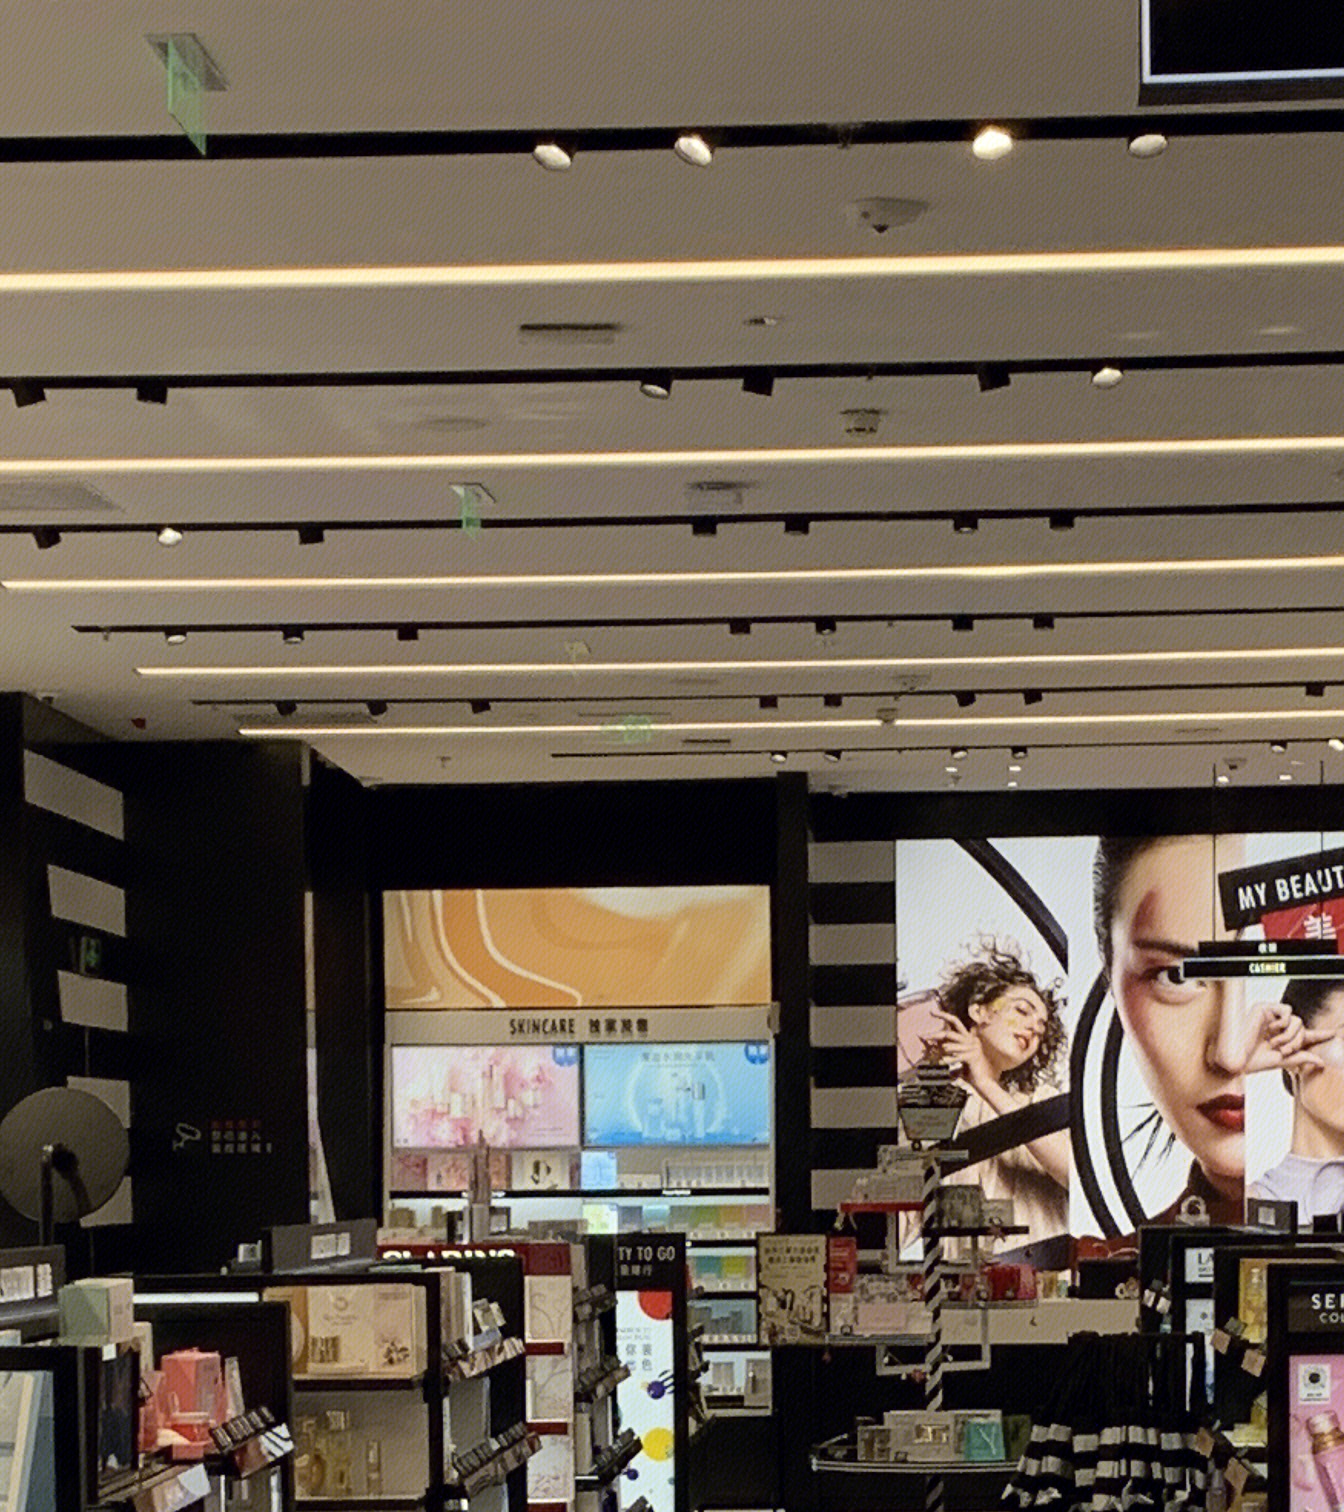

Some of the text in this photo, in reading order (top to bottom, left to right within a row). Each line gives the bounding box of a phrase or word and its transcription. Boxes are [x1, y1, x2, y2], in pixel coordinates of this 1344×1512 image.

[1237, 882, 1268, 911] MY
[1249, 963, 1287, 974] CASHIER
[509, 1018, 576, 1035] SKINCARE
[637, 1246, 654, 1261] TO
[658, 1246, 676, 1261] GO
